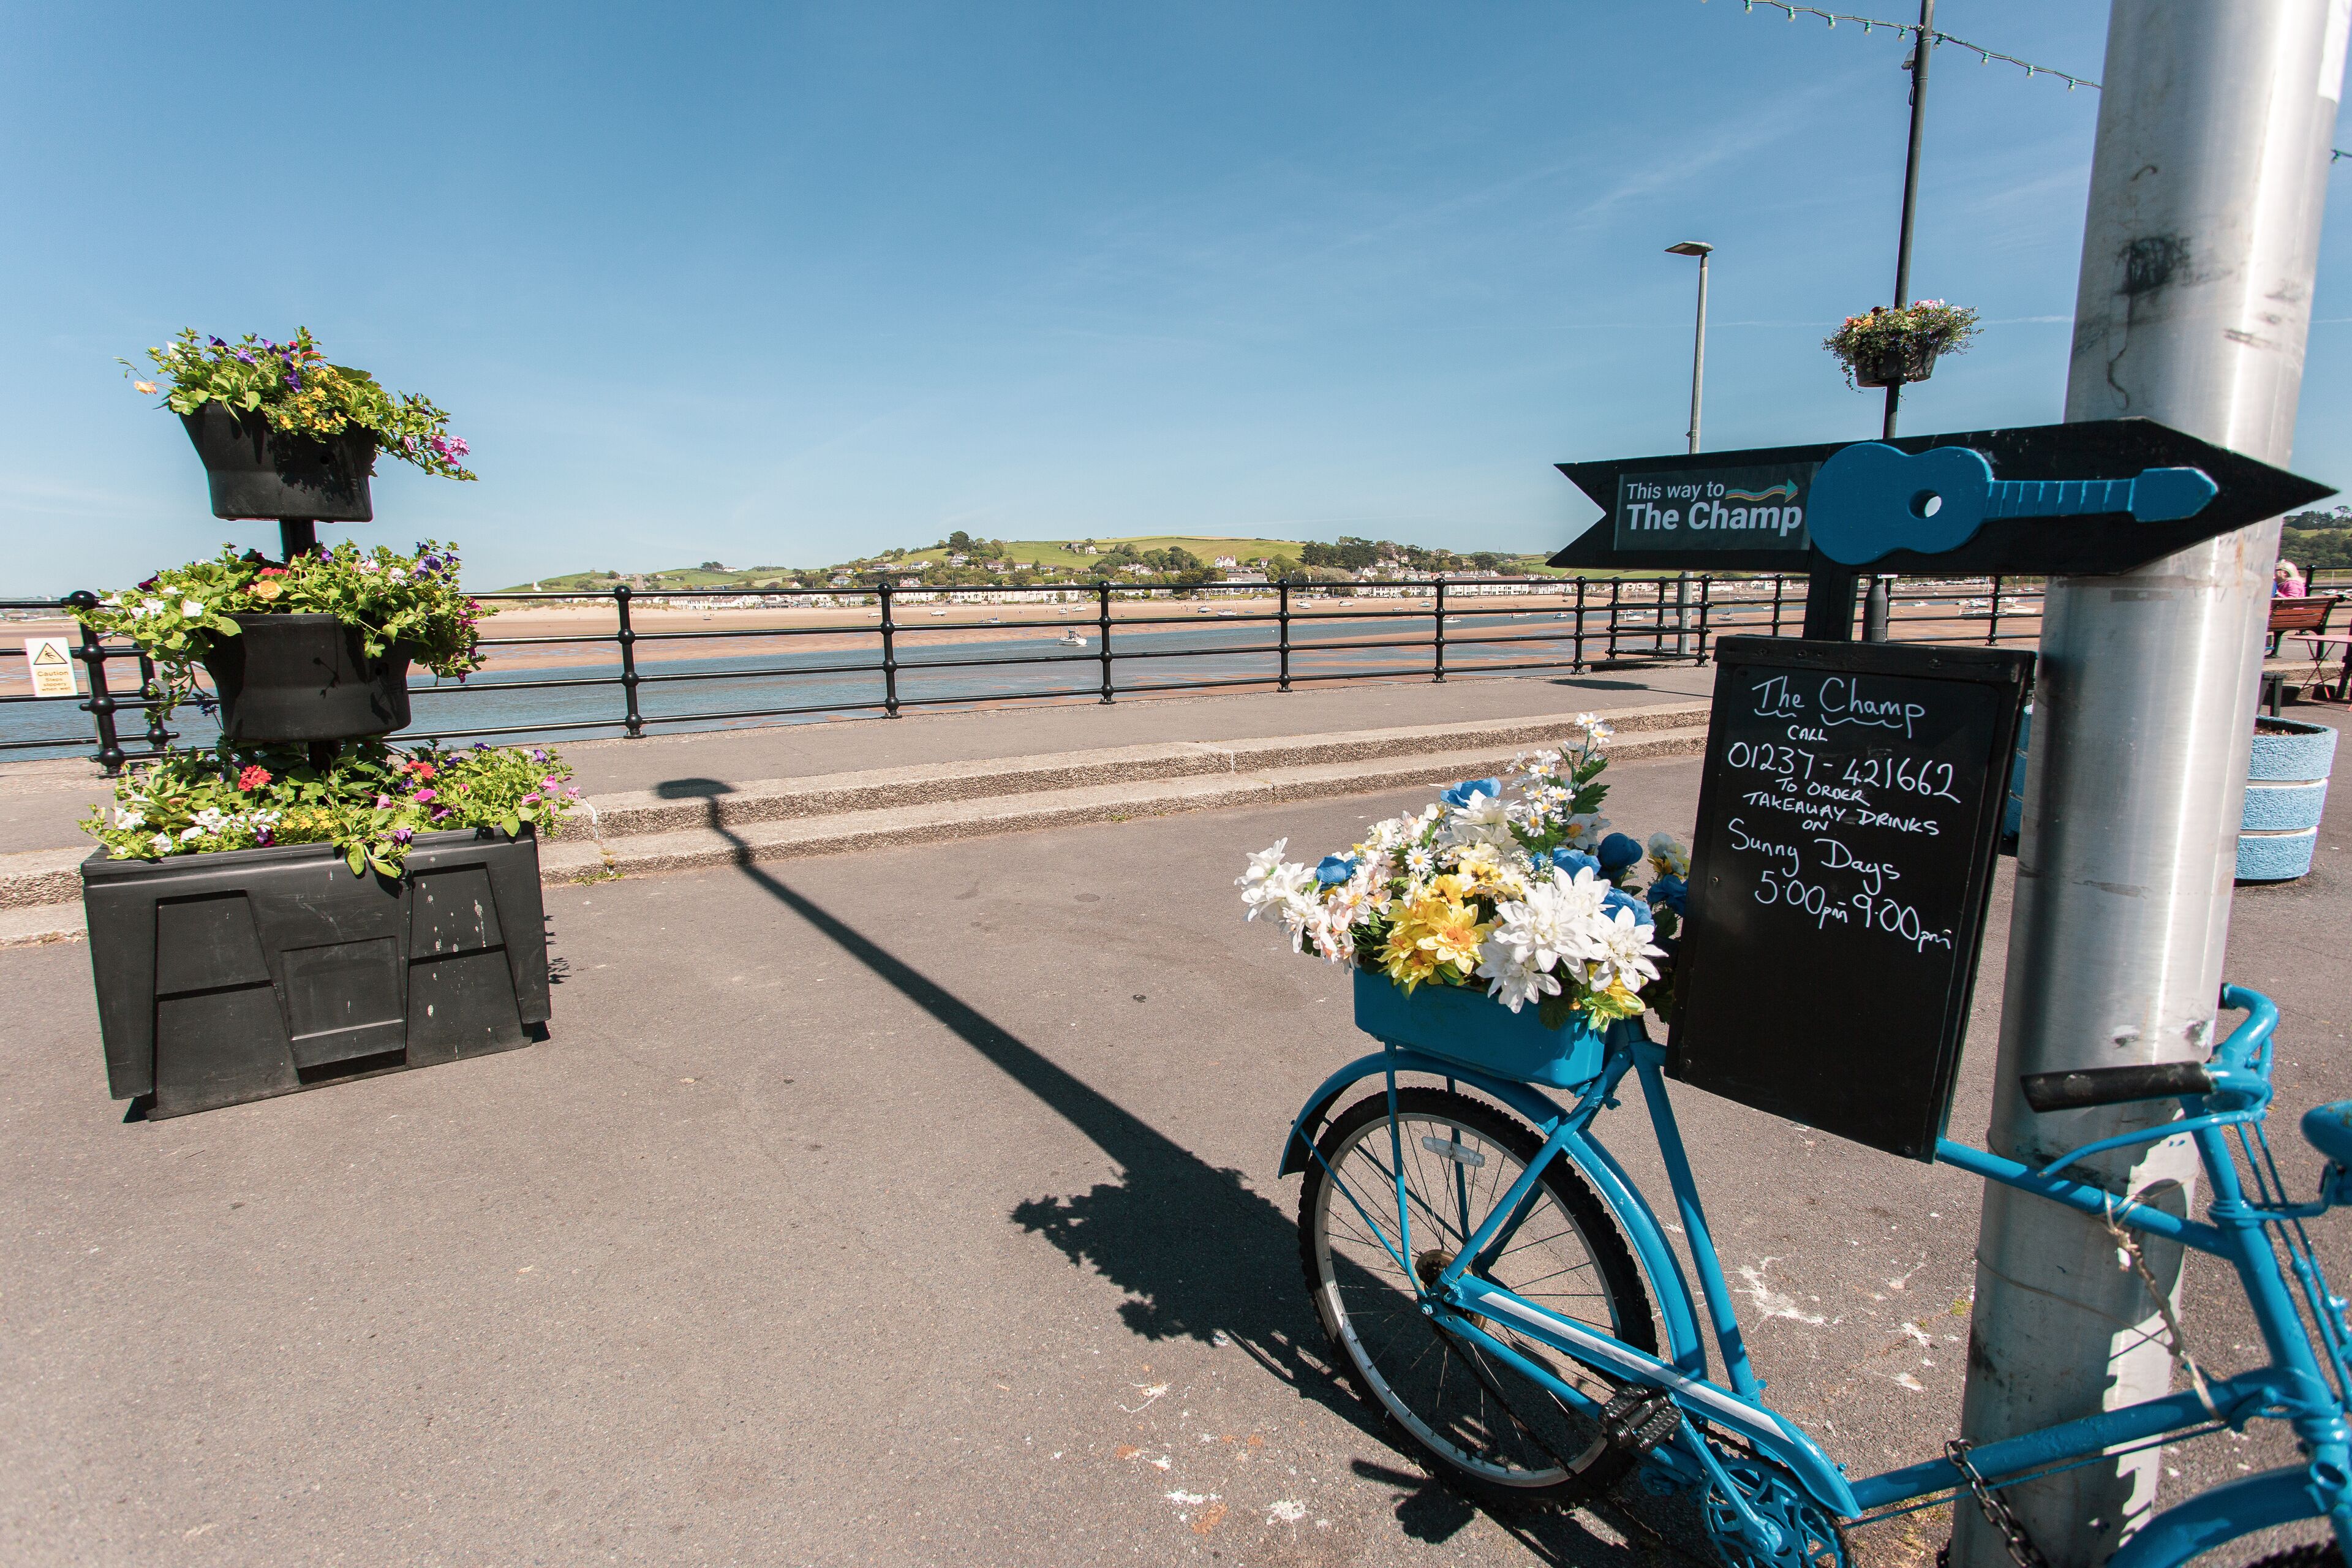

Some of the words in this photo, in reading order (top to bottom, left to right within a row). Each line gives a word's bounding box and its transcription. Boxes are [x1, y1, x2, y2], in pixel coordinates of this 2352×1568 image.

[1627, 482, 1662, 499] This
[1667, 484, 1702, 502] way
[1707, 481, 1725, 498] to
[1626, 502, 1679, 530] The
[1688, 500, 1802, 537] Champ
[1752, 676, 1805, 709] The
[1820, 677, 1926, 739] Champ
[1787, 725, 1828, 742] CALL
[1806, 781, 1871, 807] ORDER
[1743, 792, 1847, 822] TAKEAWAY
[1856, 809, 1940, 835] DRINKS
[1802, 819, 1829, 831] ON
[1728, 818, 1800, 877] Sunny
[1814, 839, 1901, 895] Days
